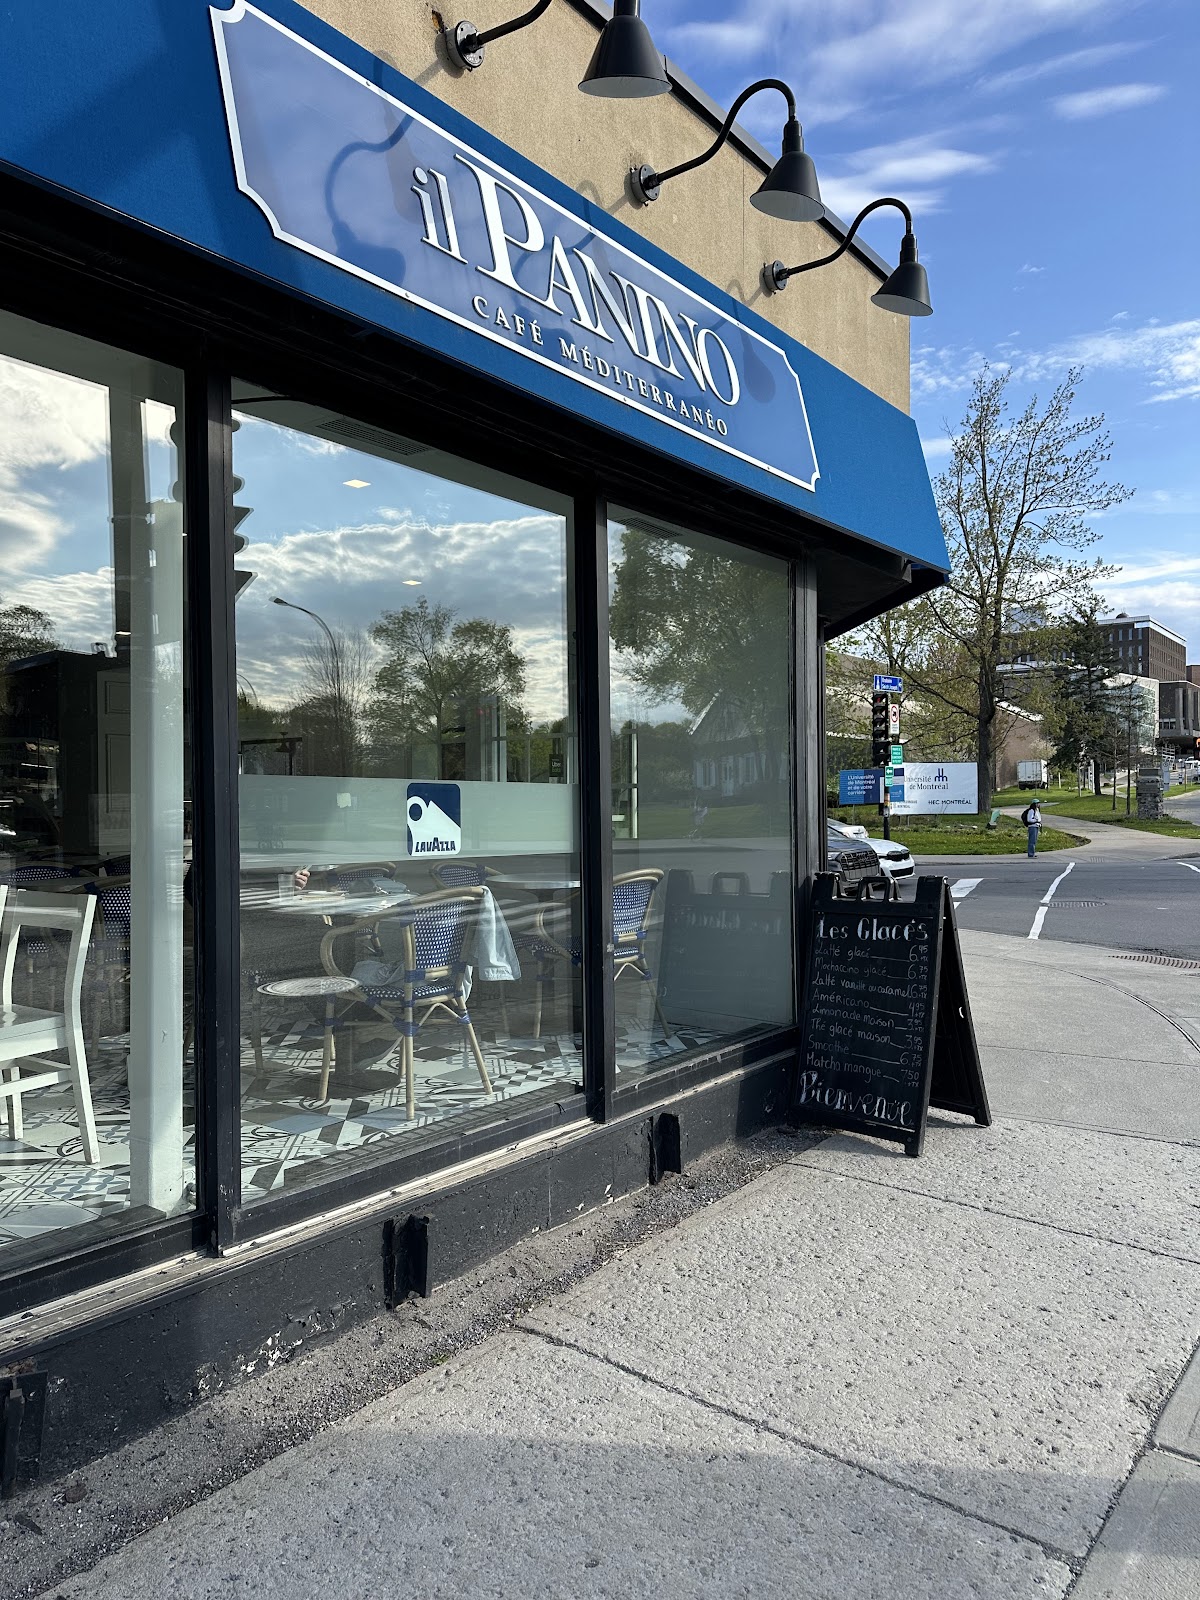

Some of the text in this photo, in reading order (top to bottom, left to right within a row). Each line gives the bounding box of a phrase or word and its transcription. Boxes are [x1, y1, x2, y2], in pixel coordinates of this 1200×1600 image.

[411, 152, 741, 407] il PANINO
[472, 294, 728, 437] CAFÉ MÉDITERRANÉO
[415, 837, 456, 853] LAVAZZA
[817, 915, 928, 941] Les Glacés
[811, 1017, 826, 1031] Thé
